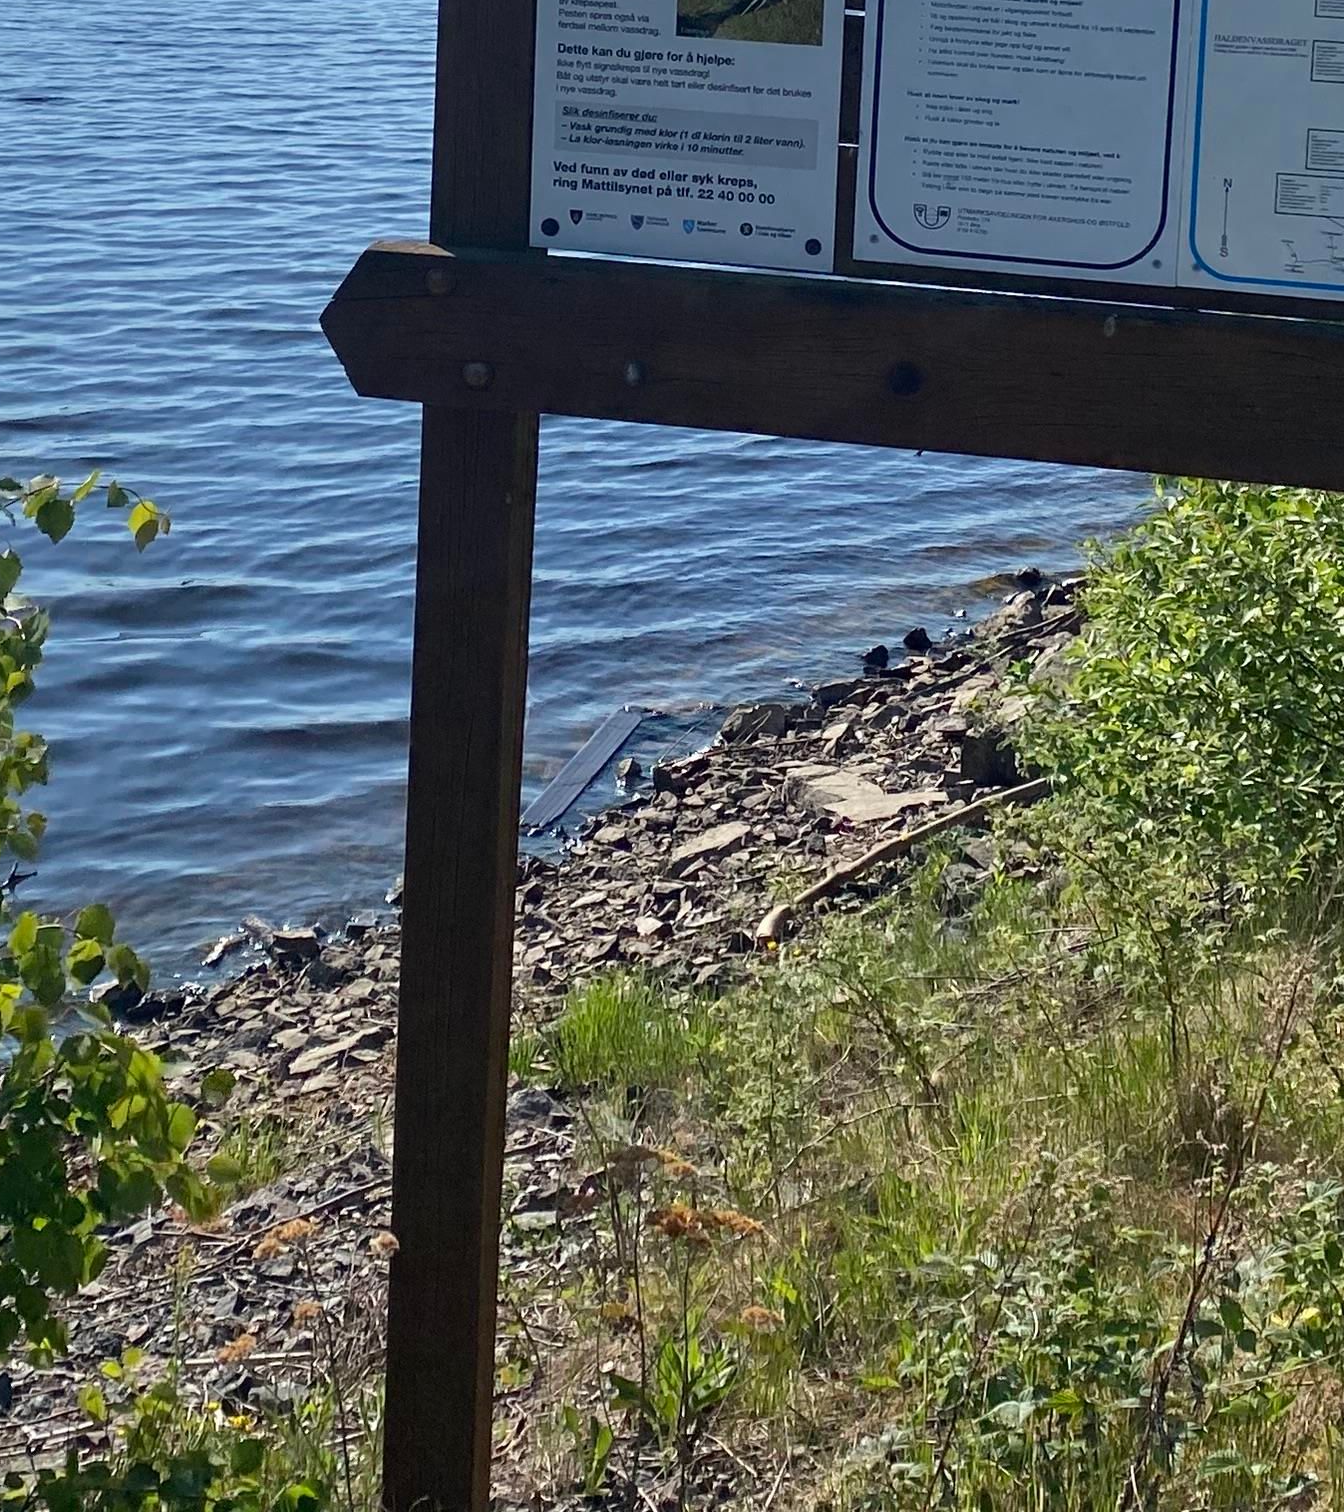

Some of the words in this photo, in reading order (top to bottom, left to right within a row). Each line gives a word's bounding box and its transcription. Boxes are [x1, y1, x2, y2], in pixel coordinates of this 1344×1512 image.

[557, 42, 588, 55] Dette
[591, 45, 613, 56] kan
[615, 47, 631, 58] du
[633, 49, 663, 63] gjøre
[666, 51, 683, 62] for
[686, 51, 693, 63] å
[696, 53, 735, 67] hjelpe:
[553, 160, 577, 173] Ved
[580, 163, 609, 175] funn
[613, 168, 627, 177] av
[631, 167, 655, 179] død
[659, 169, 688, 182] eller
[691, 172, 713, 186] syk
[717, 174, 757, 189] kreps,
[1223, 177, 1232, 188] N
[552, 176, 578, 190] ring
[581, 178, 652, 196] Mattilsynet
[656, 184, 672, 198] på
[676, 186, 693, 198] tlf.
[697, 188, 714, 199] 22
[717, 189, 734, 201] 40
[737, 191, 754, 203] 00
[758, 192, 775, 204] 00
[1219, 246, 1229, 257] S
